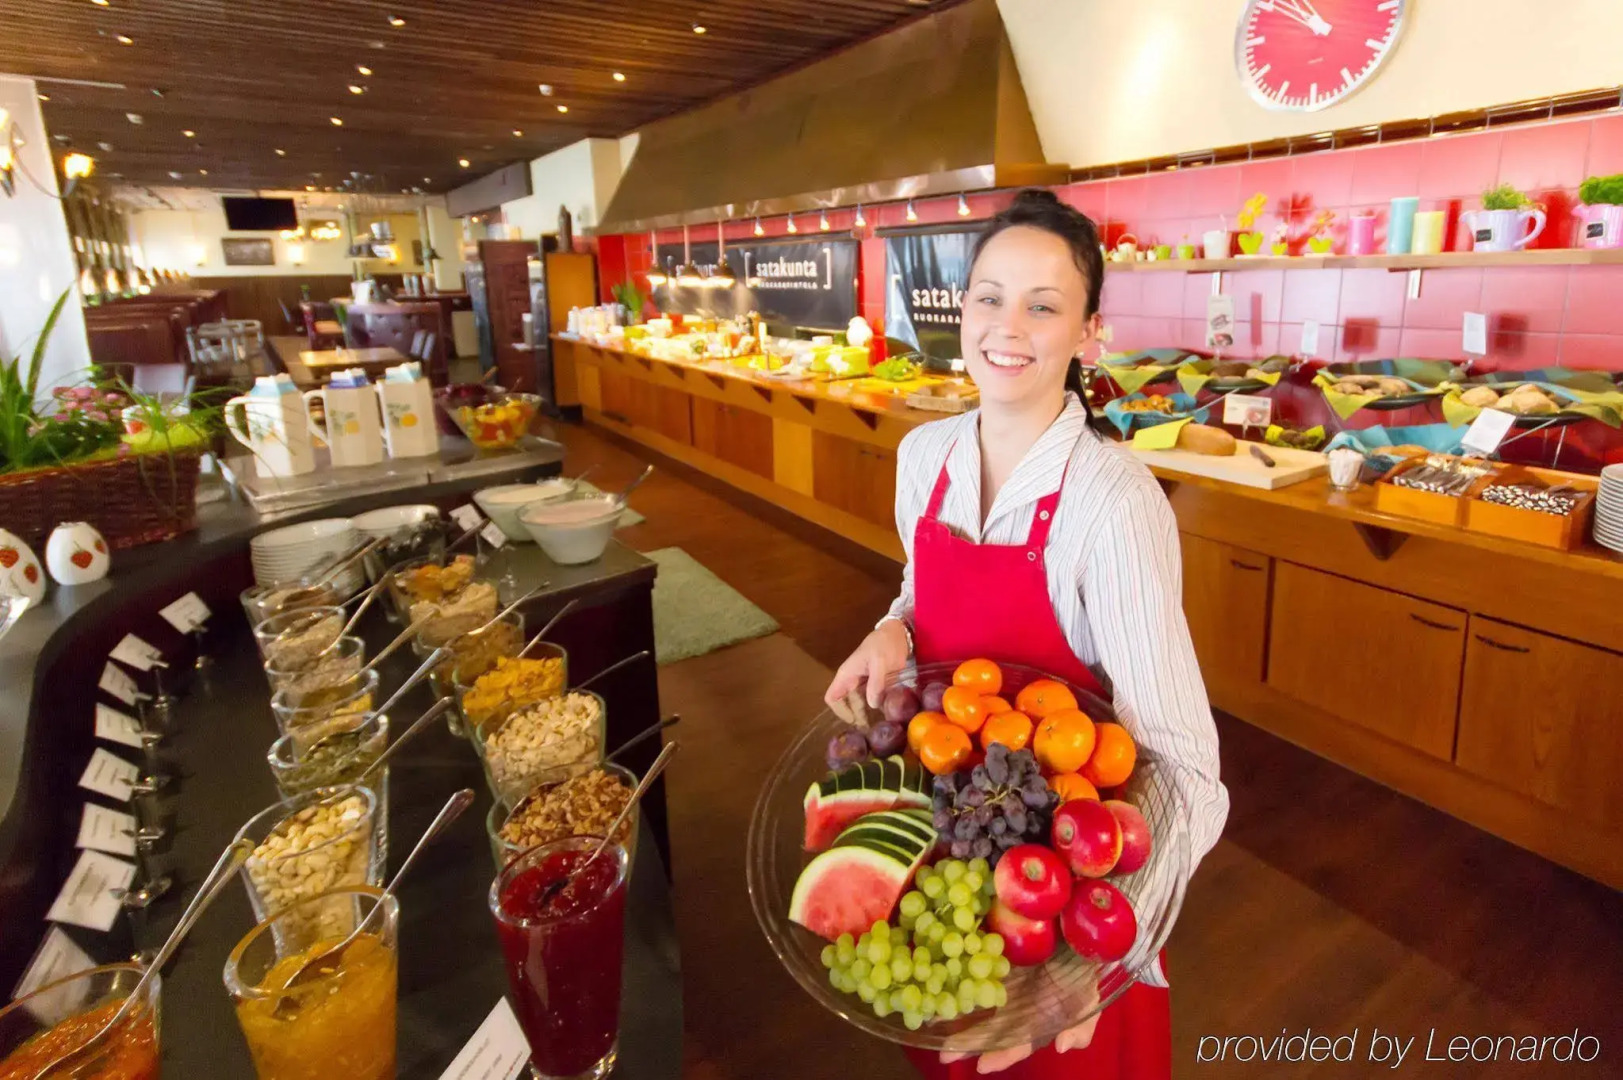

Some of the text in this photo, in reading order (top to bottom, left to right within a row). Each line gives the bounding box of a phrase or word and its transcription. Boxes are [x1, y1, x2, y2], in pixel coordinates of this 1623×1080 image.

[756, 256, 817, 277] satakunta
[912, 281, 968, 308] satak
[913, 312, 961, 324] RUOKARA
